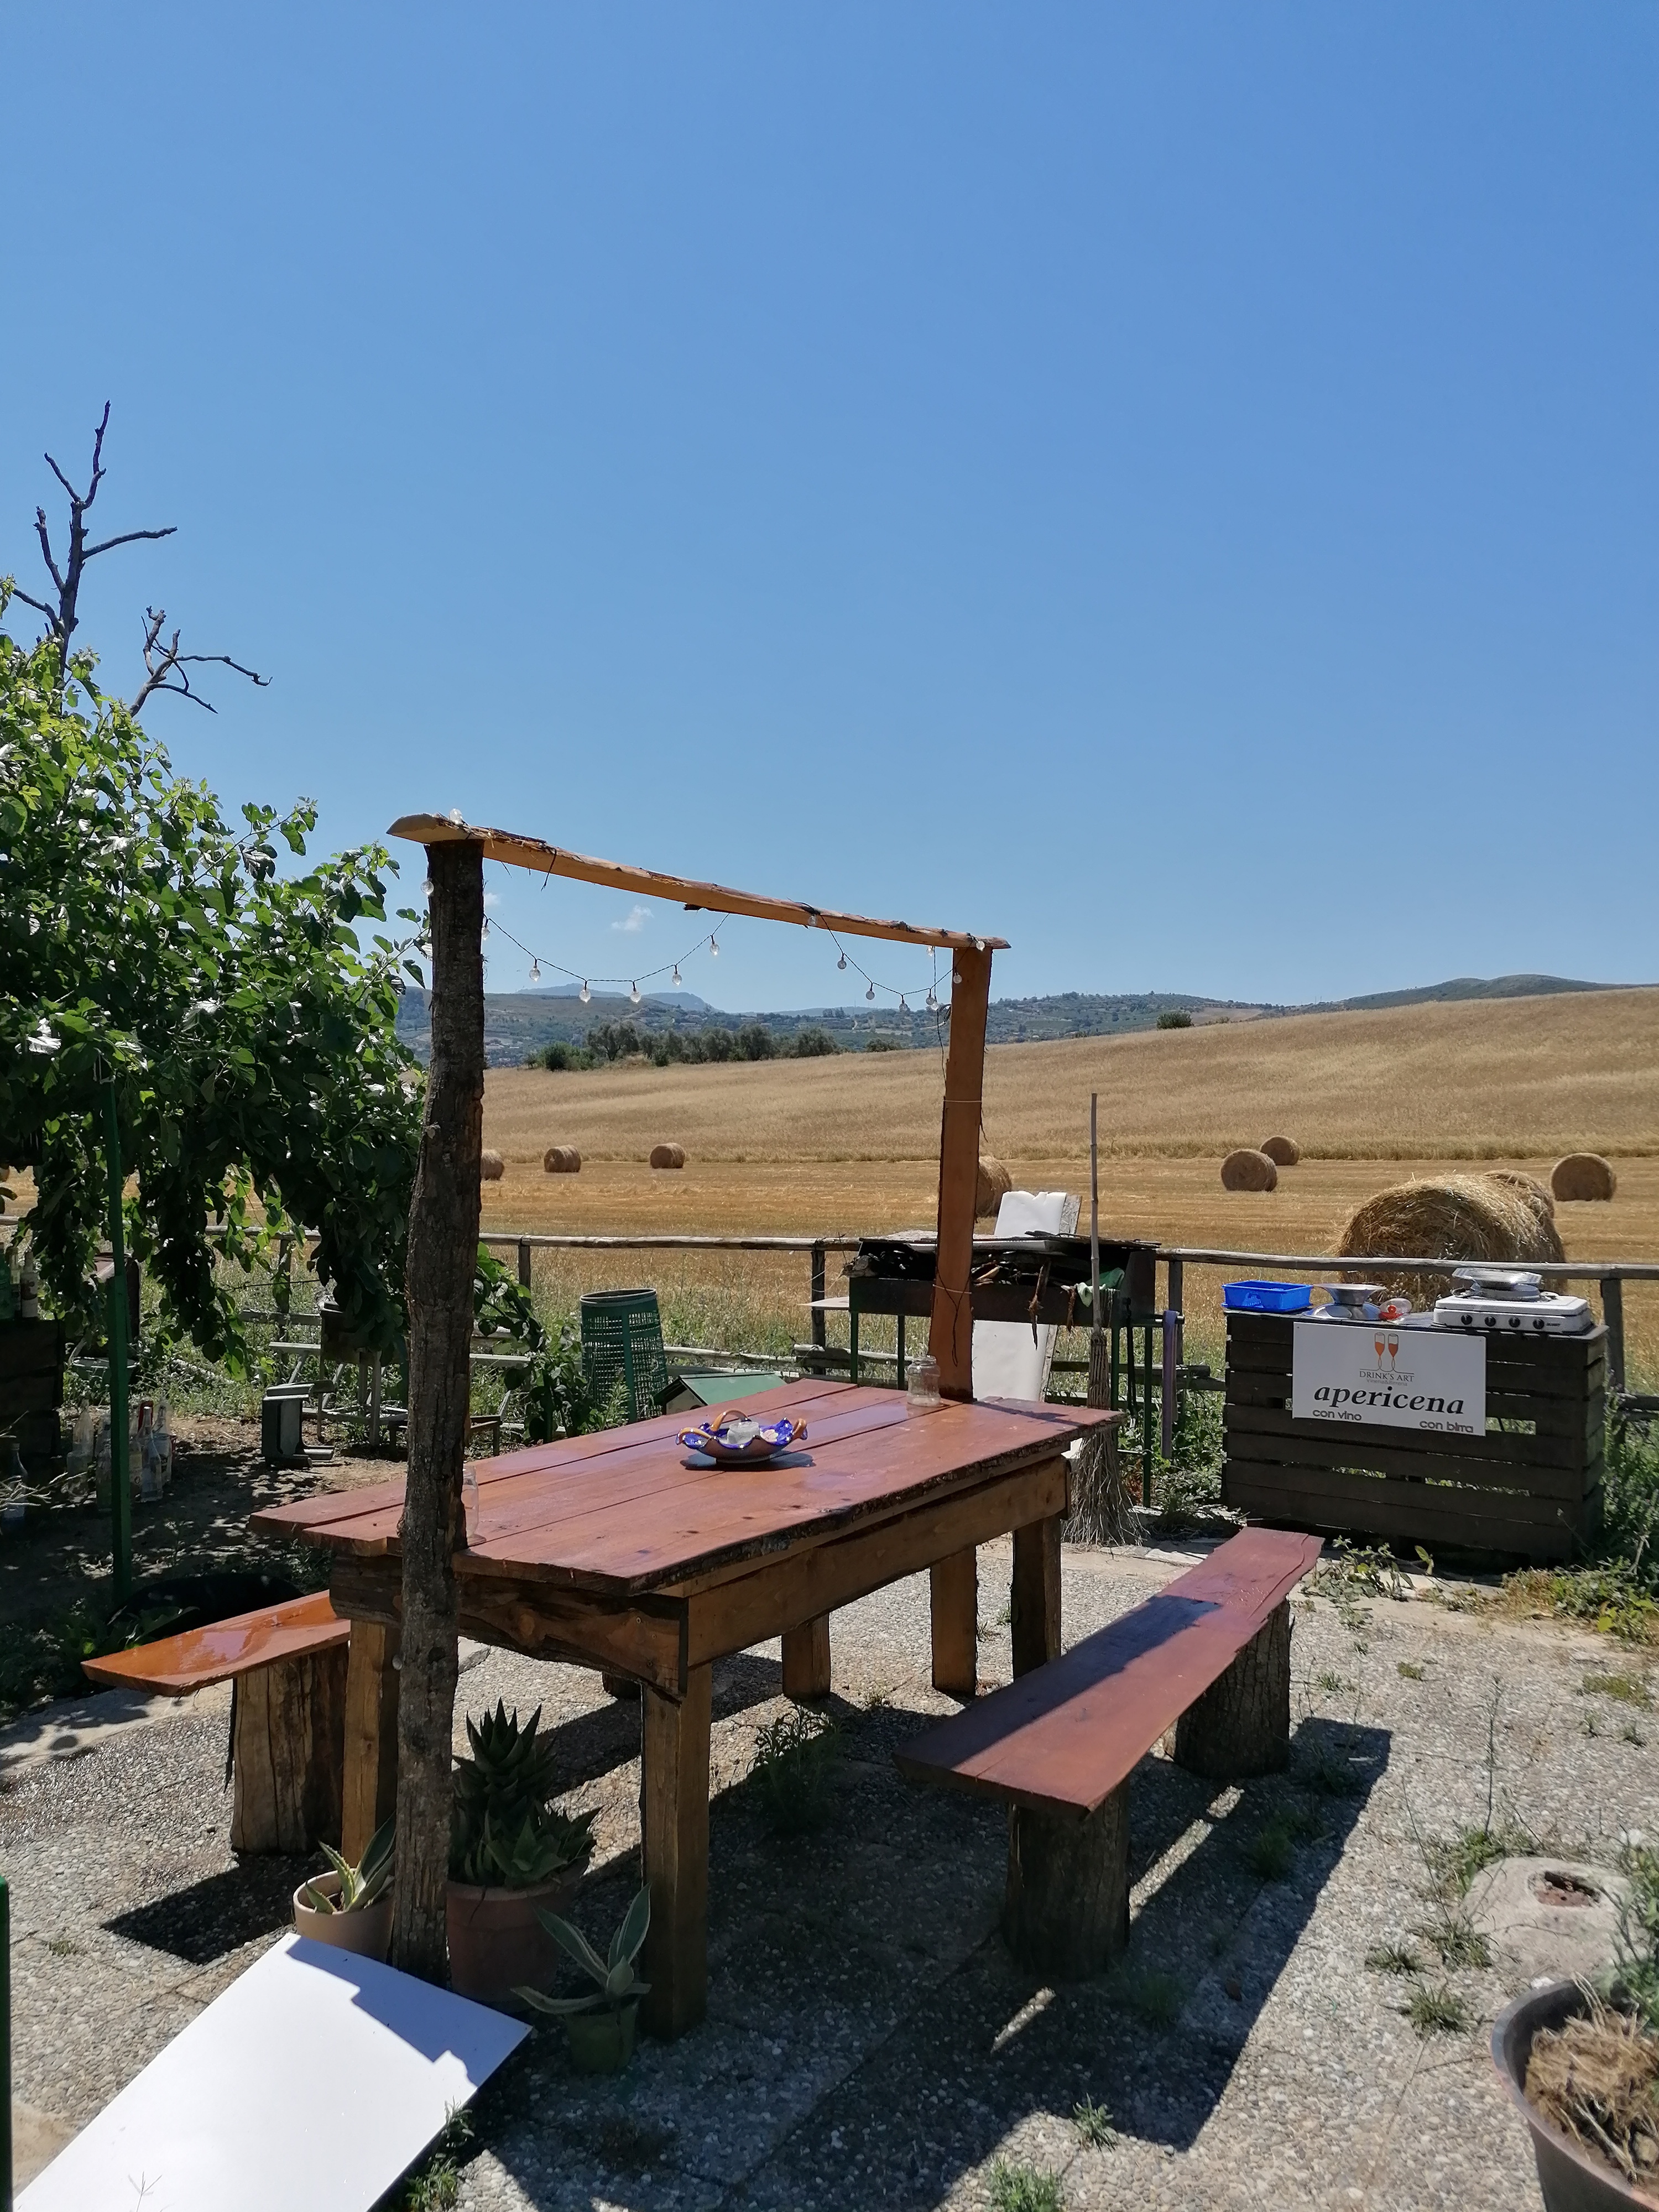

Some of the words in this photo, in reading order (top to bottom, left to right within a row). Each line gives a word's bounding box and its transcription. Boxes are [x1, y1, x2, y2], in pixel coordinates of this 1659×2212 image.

[1396, 1374, 1415, 1383] ART
[1313, 1385, 1464, 1415] apericena
[1312, 1410, 1335, 1419] con
[1337, 1410, 1363, 1421] vino
[1419, 1420, 1443, 1431] con
[1446, 1421, 1474, 1433] birra
